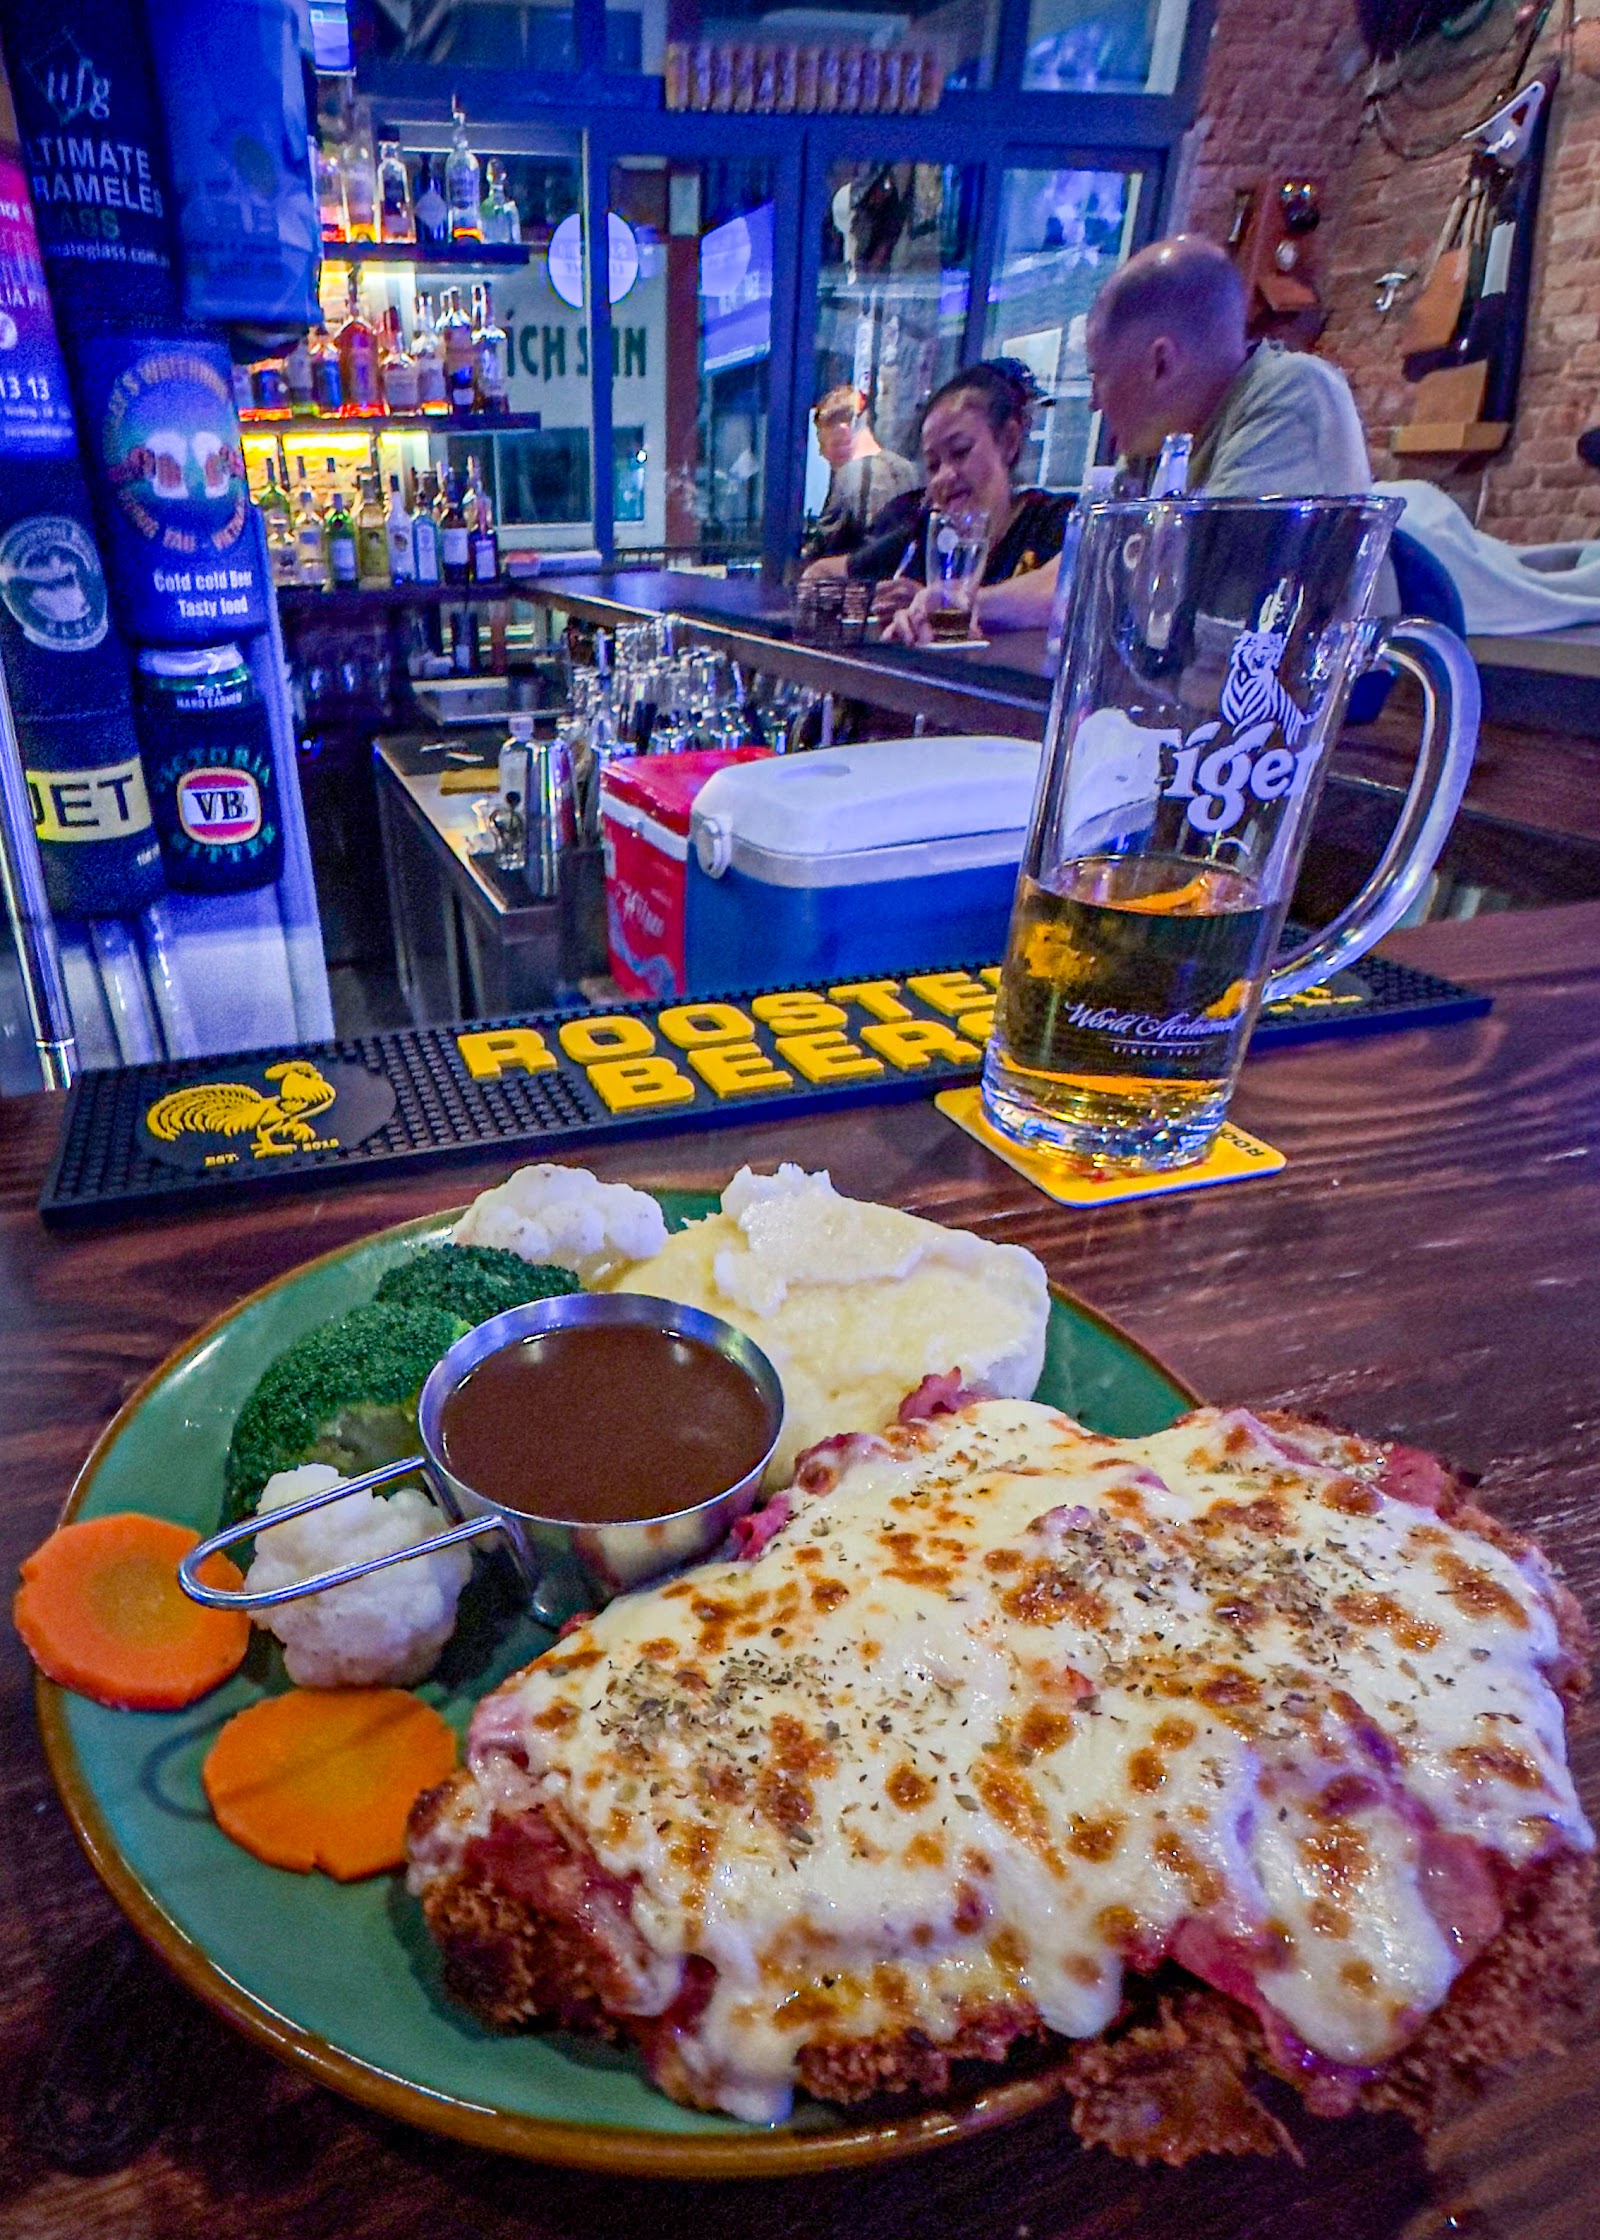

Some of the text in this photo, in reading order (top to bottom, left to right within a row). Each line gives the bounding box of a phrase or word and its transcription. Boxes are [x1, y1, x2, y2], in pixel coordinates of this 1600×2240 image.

[153, 568, 192, 592] Cold
[195, 569, 228, 590] cold
[178, 594, 248, 619] Tasty food
[1128, 720, 1324, 834] Tiger
[191, 790, 249, 822] VB
[457, 966, 1002, 1079] ROOSTE
[1065, 1001, 1139, 1033] World
